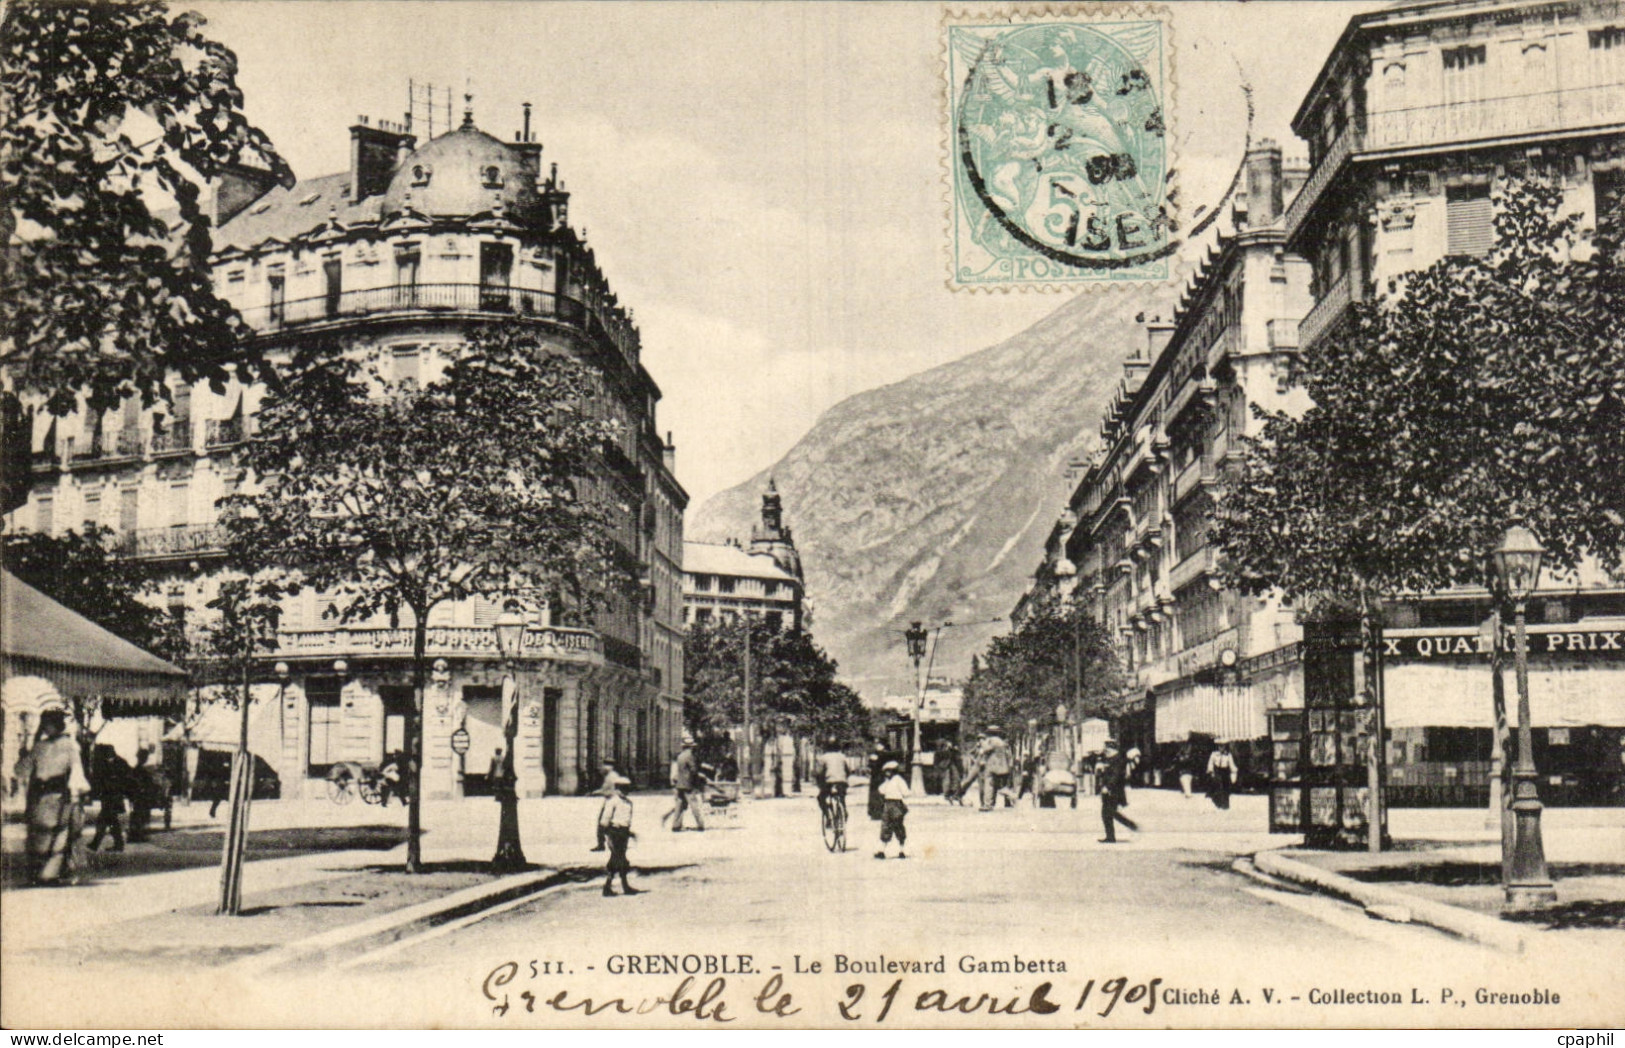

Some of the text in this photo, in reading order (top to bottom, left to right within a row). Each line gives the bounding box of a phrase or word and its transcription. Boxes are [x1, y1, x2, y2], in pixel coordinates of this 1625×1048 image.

[1546, 631, 1622, 652] PRIX
[482, 961, 737, 1022] Grenoble
[753, 973, 802, 1017] le
[838, 978, 902, 1022] 21
